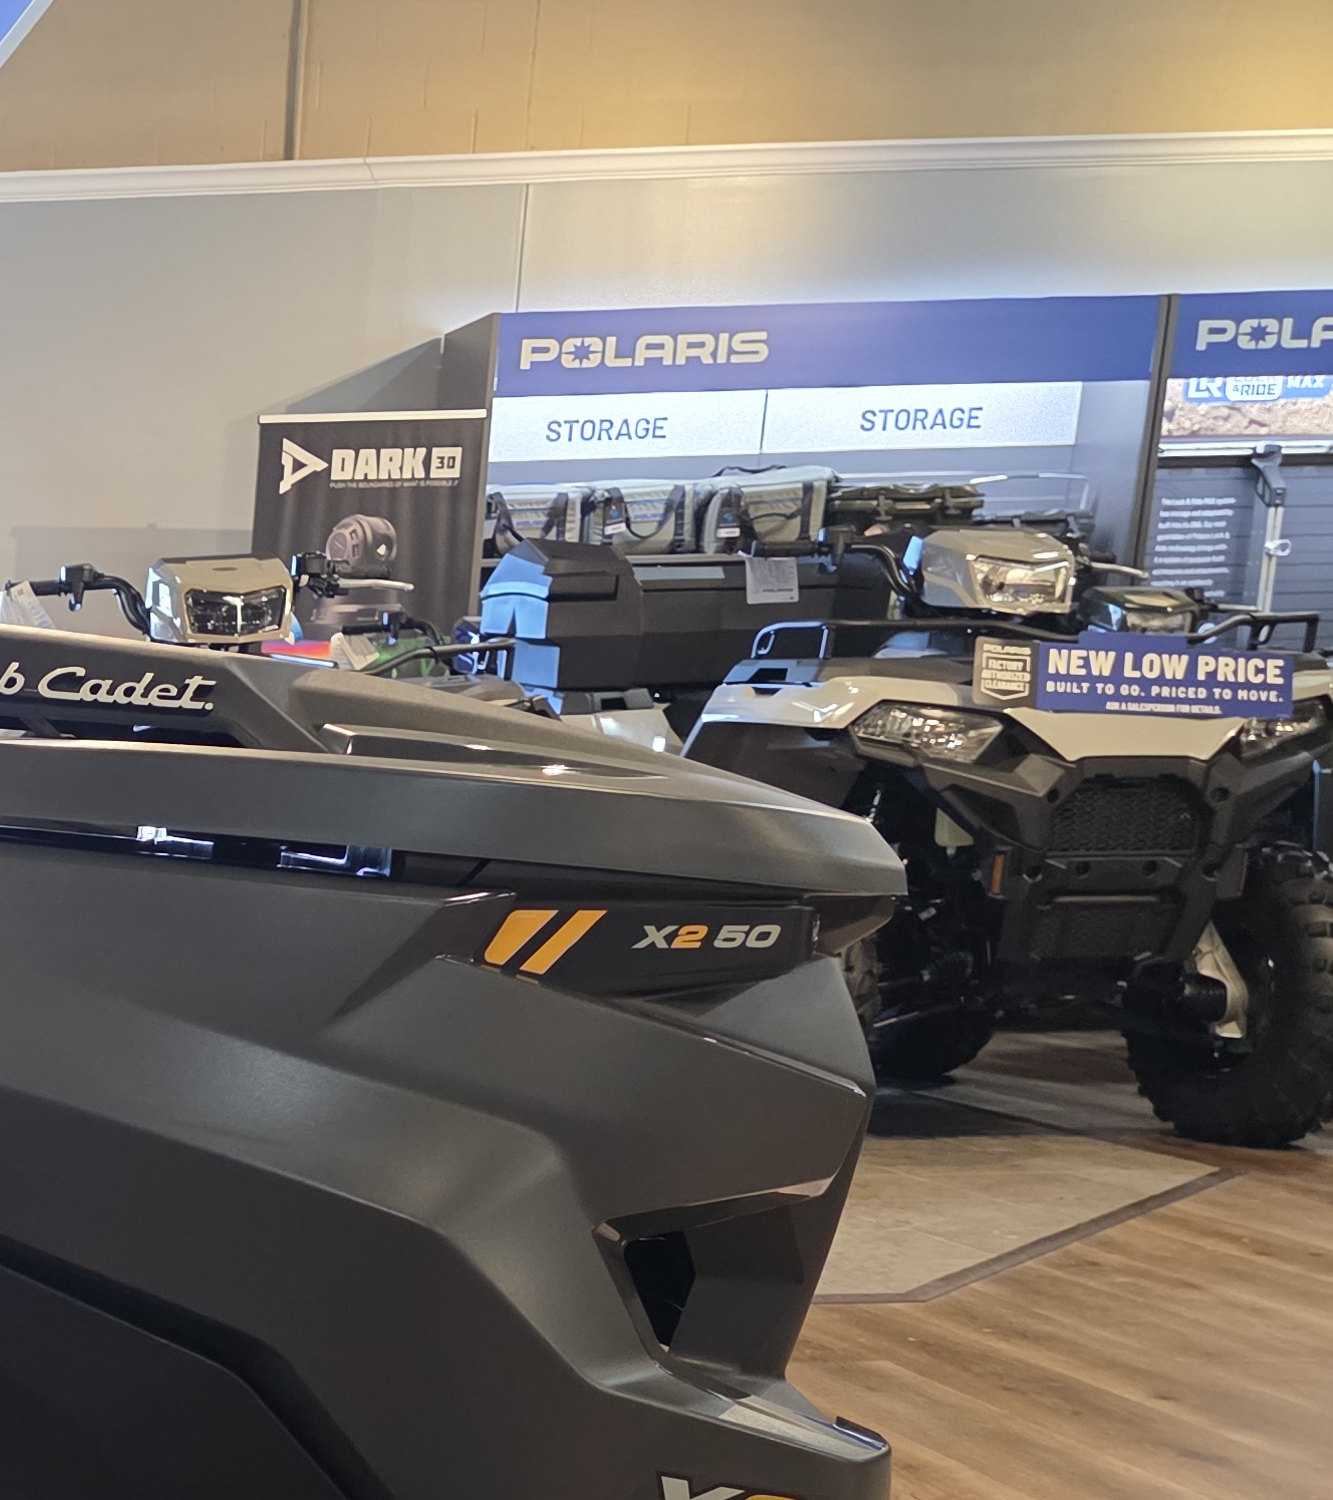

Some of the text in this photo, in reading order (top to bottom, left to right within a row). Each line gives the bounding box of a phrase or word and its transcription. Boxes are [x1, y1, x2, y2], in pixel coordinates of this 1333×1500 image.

[520, 331, 769, 370] POLARIS
[546, 416, 669, 442] STORAGE
[859, 407, 984, 432] STORAGE
[331, 447, 427, 480] DARK
[1048, 648, 1285, 685] NEW LOW PRICE
[1046, 681, 1284, 703] BUILT TO GO. PRICED TO MOVE.
